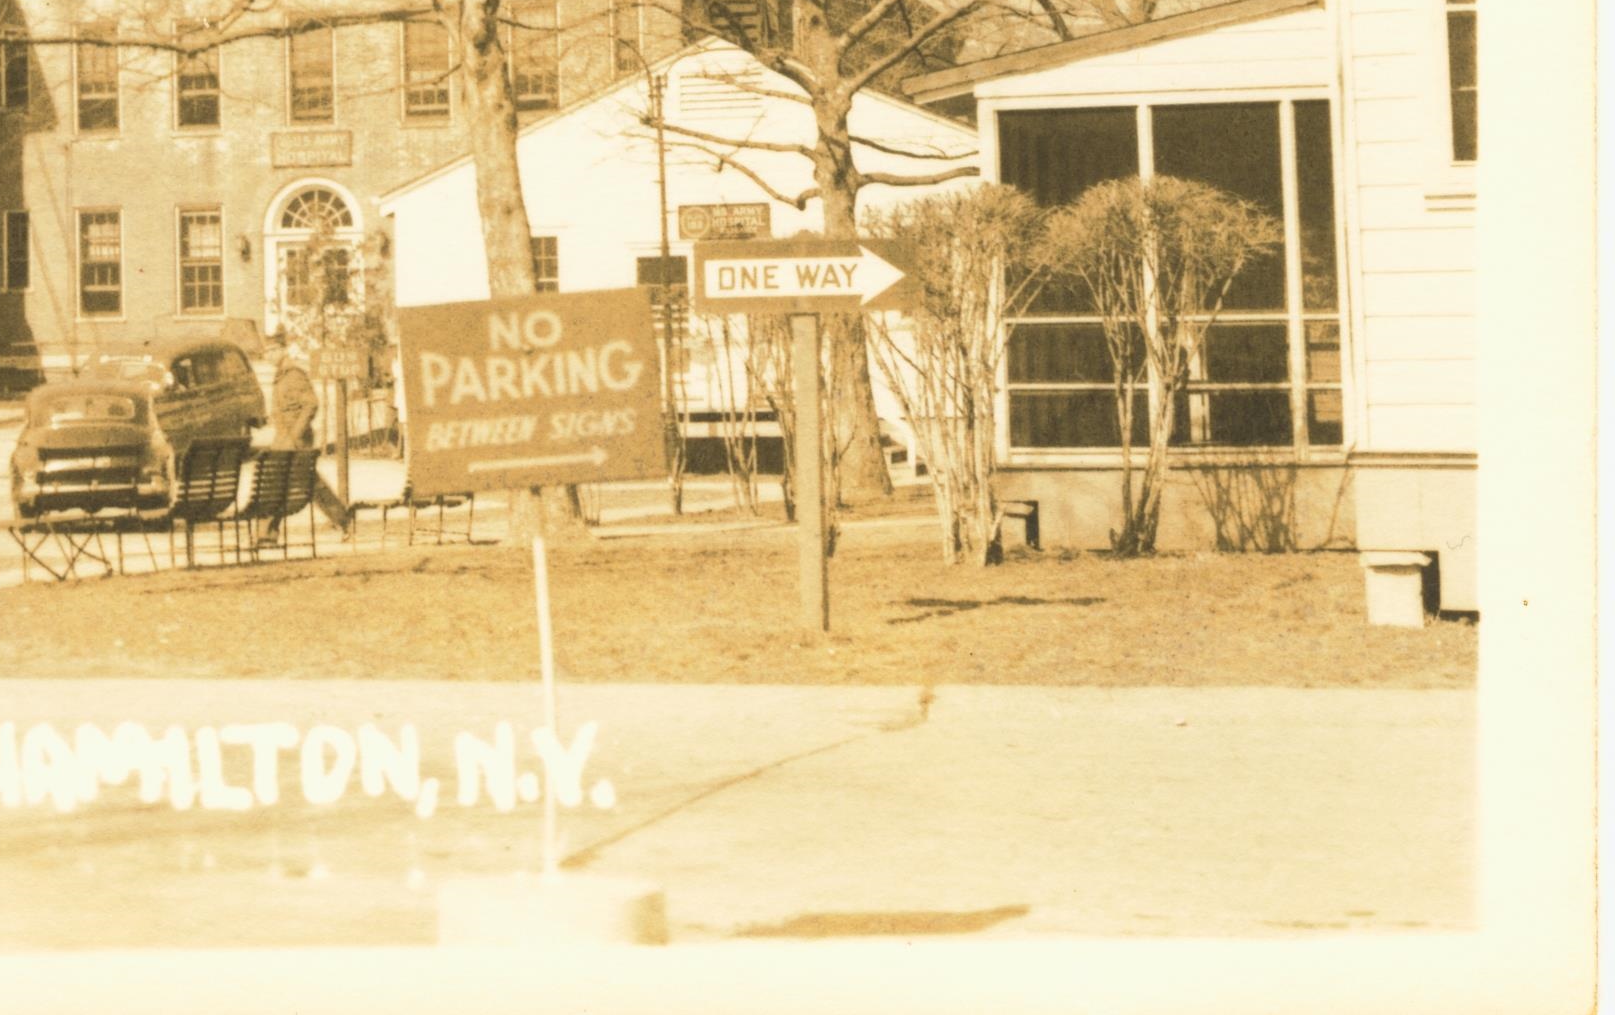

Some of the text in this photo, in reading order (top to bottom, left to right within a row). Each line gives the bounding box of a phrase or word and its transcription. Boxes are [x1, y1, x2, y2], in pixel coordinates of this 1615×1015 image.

[276, 150, 348, 164] HOSPITAL
[733, 205, 763, 216] ARMY
[712, 215, 766, 228] HOSPITAL
[718, 263, 859, 291] ONE WAY
[487, 309, 563, 351] NO
[320, 351, 358, 363] BUS
[318, 364, 361, 377] STOP
[419, 339, 644, 409] PARKING
[424, 408, 637, 452] BETWEEN SIGNS
